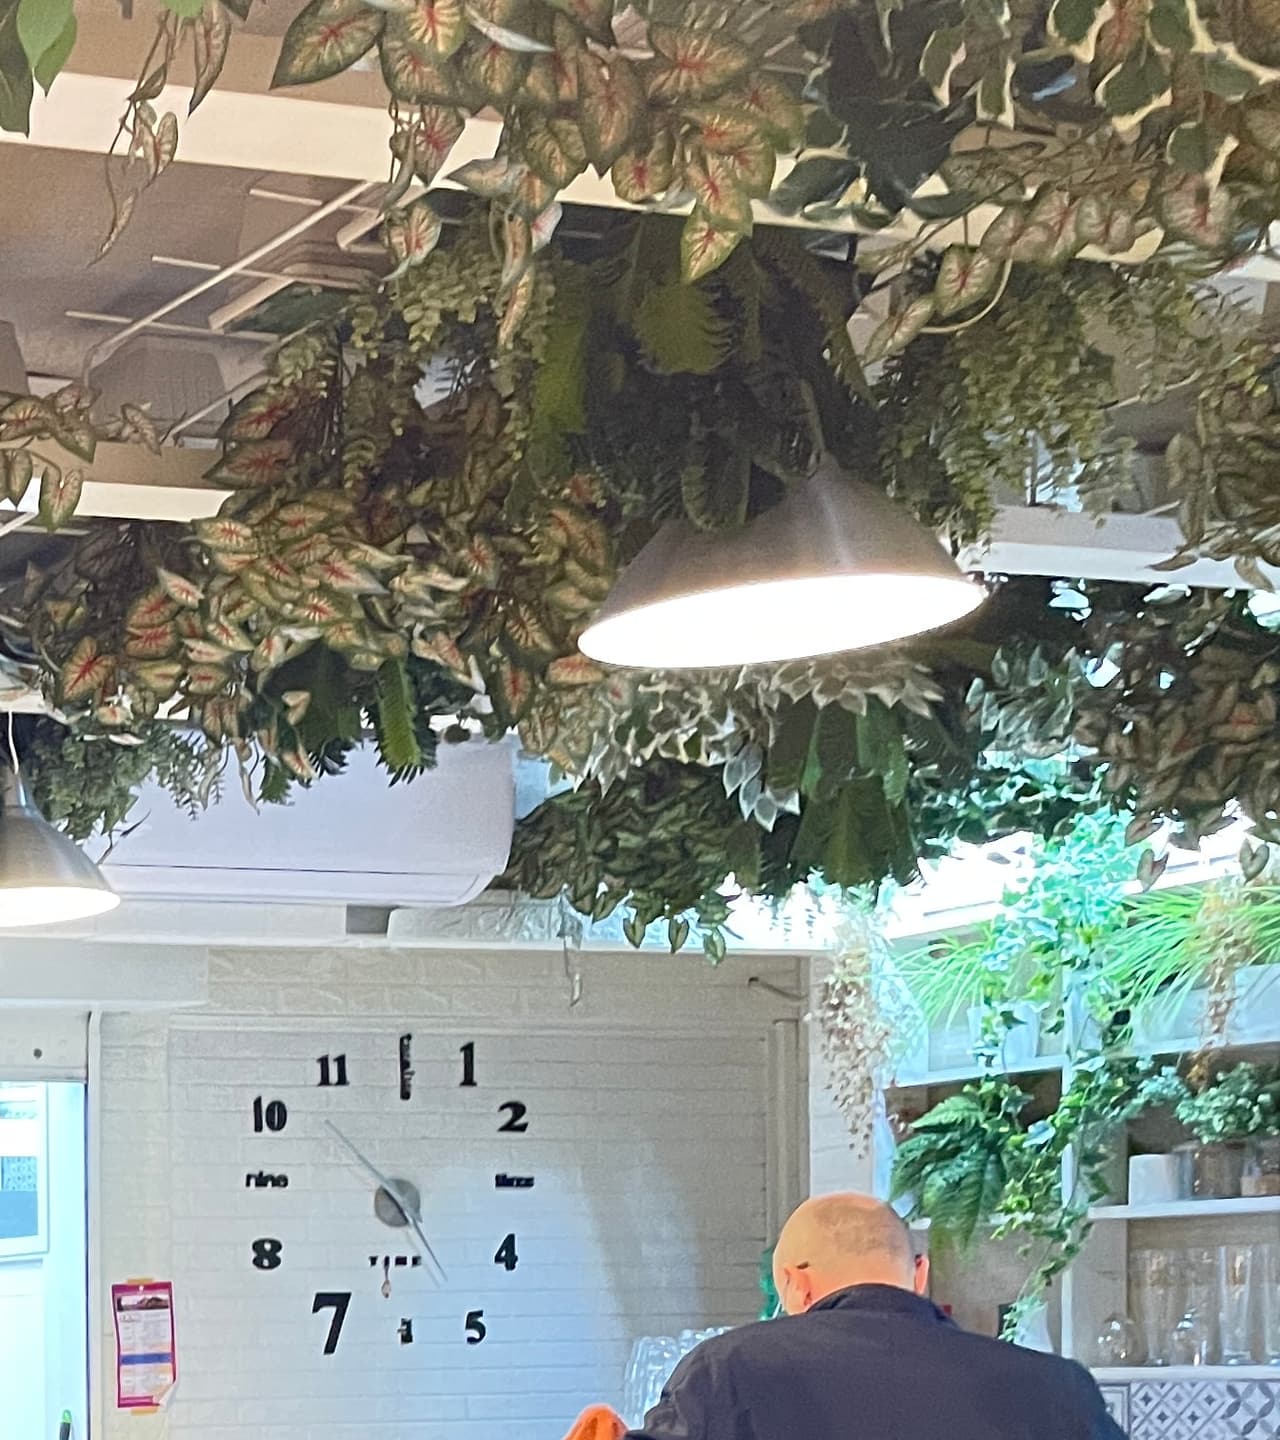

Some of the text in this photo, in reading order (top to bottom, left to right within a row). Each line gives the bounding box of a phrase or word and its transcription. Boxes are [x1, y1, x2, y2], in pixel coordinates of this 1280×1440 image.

[316, 1054, 350, 1087] 11
[459, 1041, 477, 1087] 1
[253, 1096, 288, 1133] 10
[497, 1101, 529, 1132] 2
[252, 1238, 283, 1270] 8
[494, 1233, 518, 1271] 4
[312, 1292, 352, 1355] 7
[465, 1309, 486, 1345] 5
